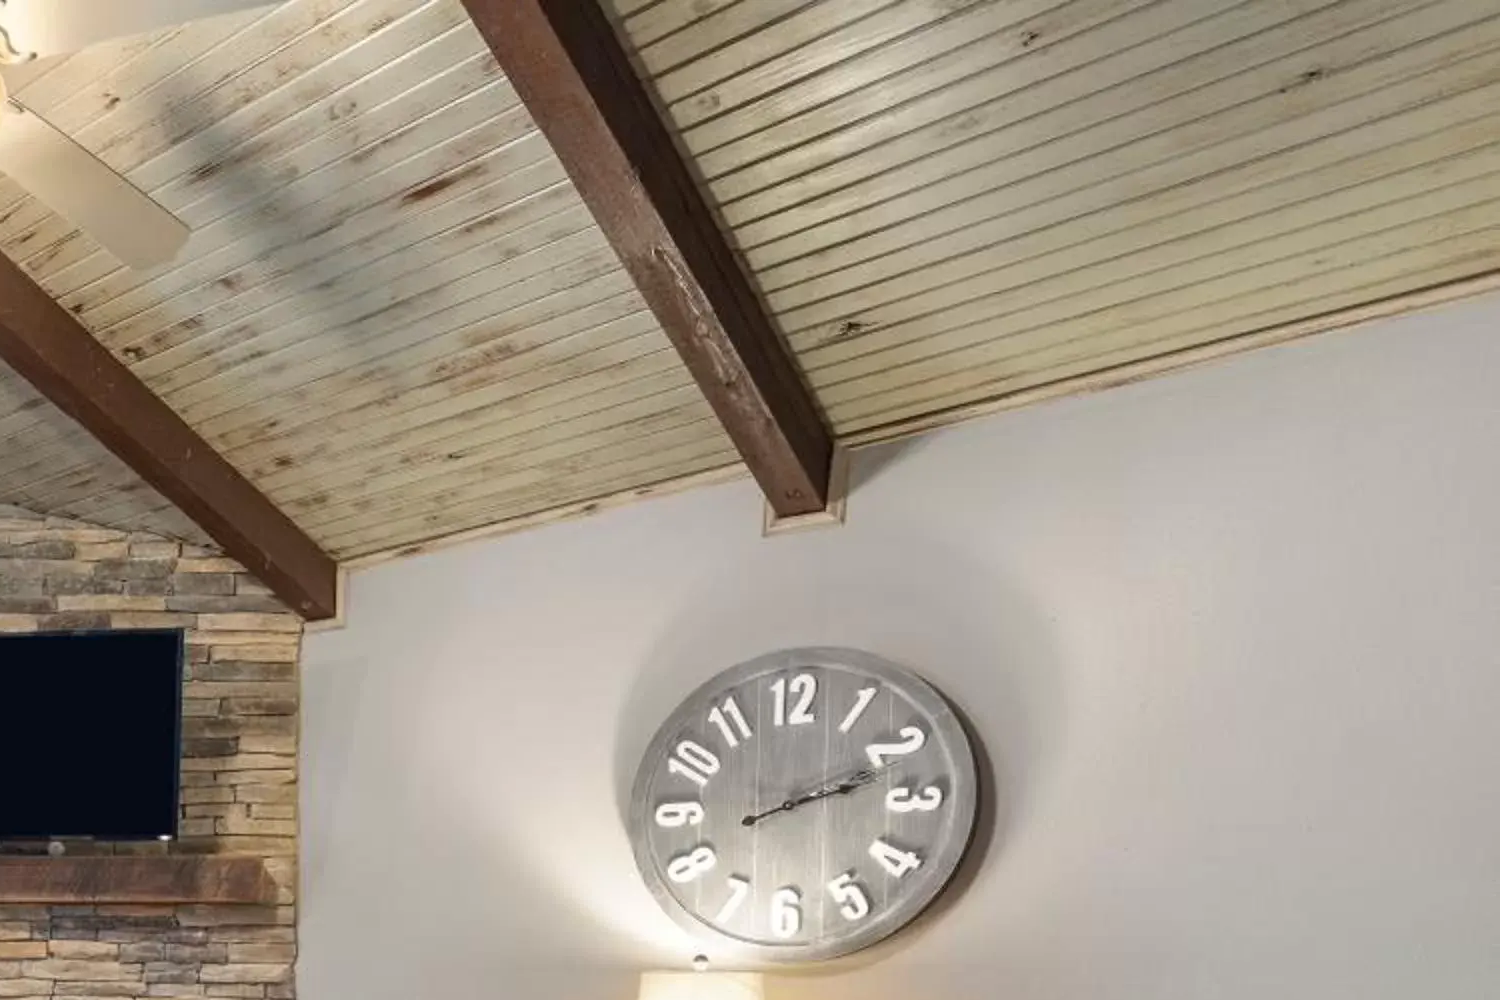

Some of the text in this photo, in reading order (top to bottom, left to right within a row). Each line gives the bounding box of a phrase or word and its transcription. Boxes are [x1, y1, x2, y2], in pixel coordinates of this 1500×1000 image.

[707, 696, 753, 748] 11
[770, 674, 818, 726] 12
[837, 687, 878, 732] 1
[667, 739, 722, 787] 10
[864, 726, 926, 768] 2
[655, 800, 705, 829] 9
[886, 785, 943, 812] 3
[667, 845, 718, 883] 8
[868, 838, 924, 878] 4
[716, 874, 752, 924] 7
[769, 888, 801, 939] 6
[827, 873, 870, 921] 5
